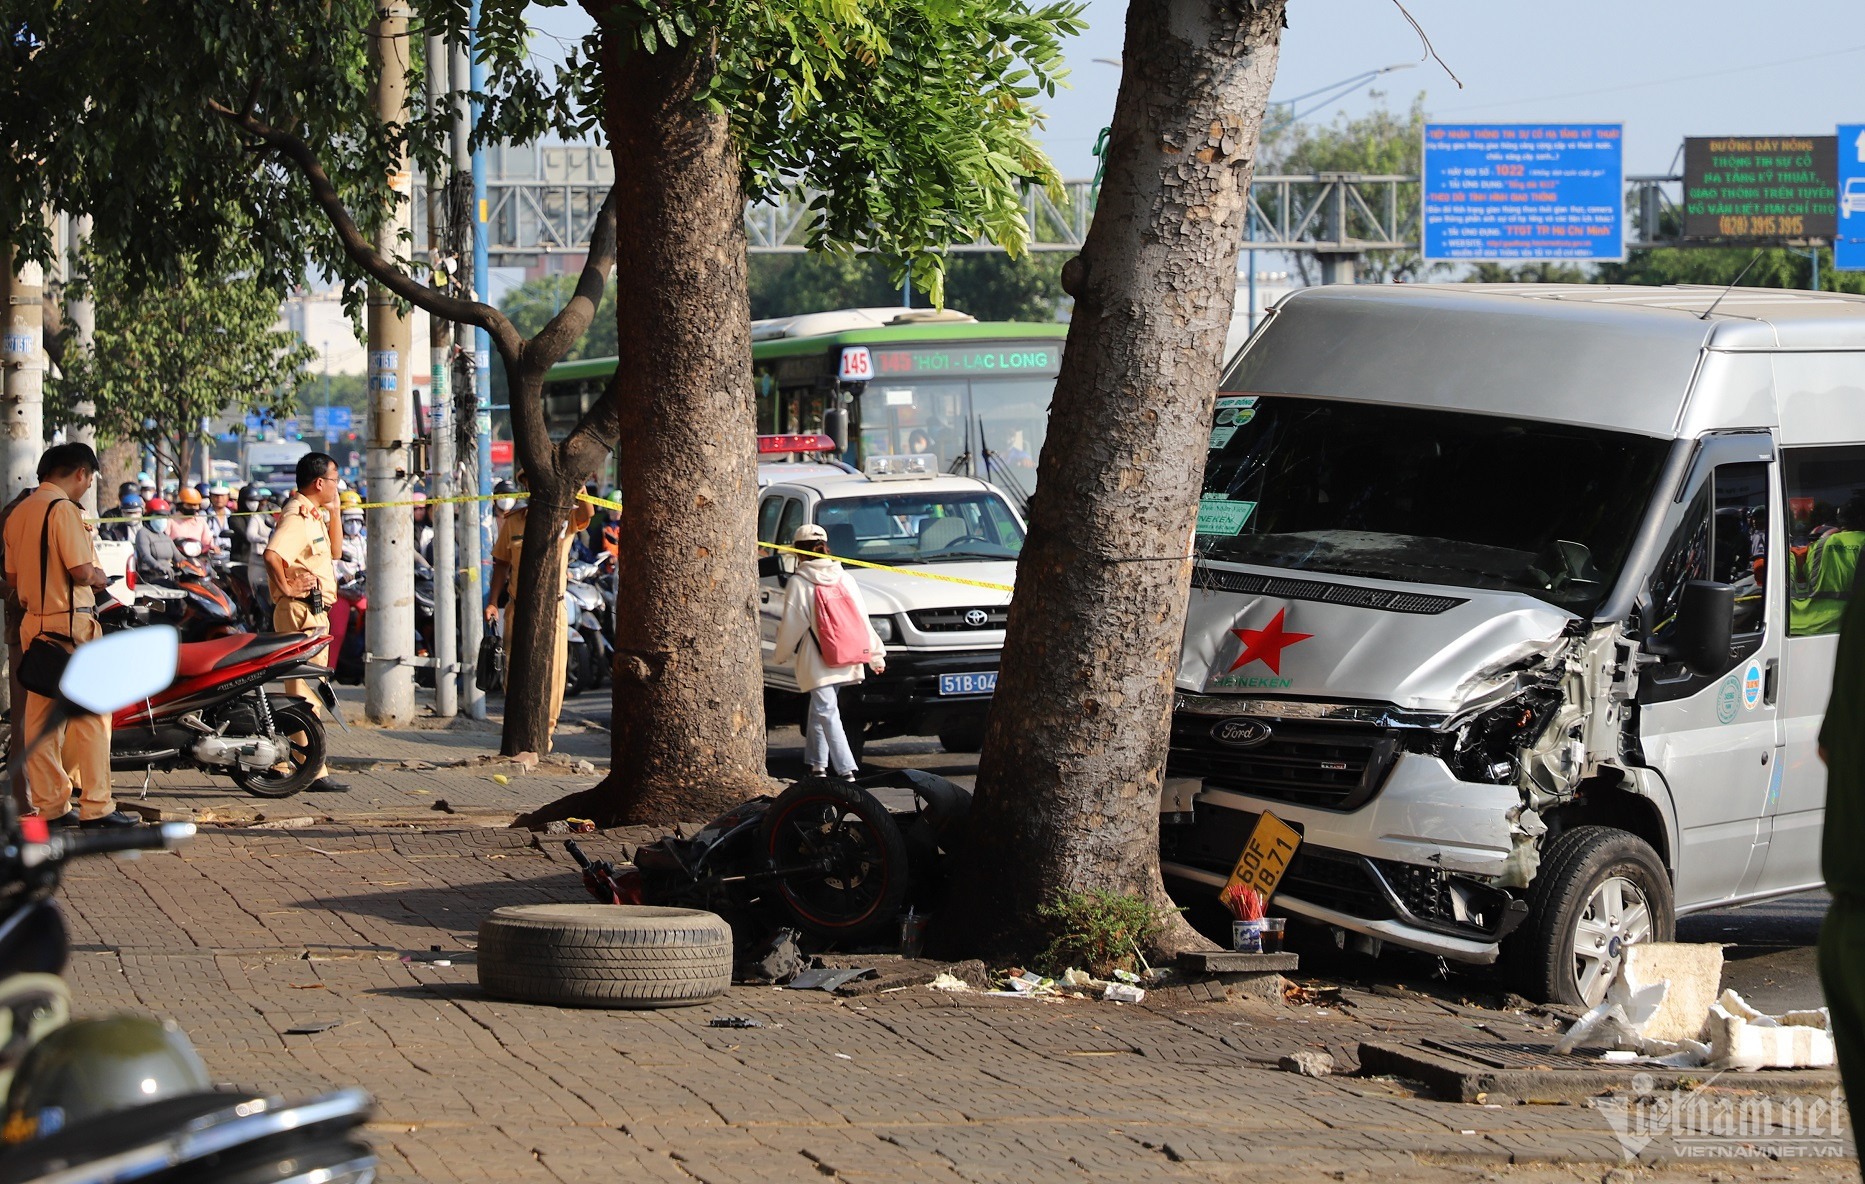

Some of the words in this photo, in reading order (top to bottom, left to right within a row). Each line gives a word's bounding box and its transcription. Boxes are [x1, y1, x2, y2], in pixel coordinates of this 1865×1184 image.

[1496, 164, 1525, 177] 1022
[842, 353, 868, 374] 145
[1000, 351, 1048, 369] LONG
[1221, 722, 1255, 739] Ford
[1236, 837, 1265, 884] 60F
